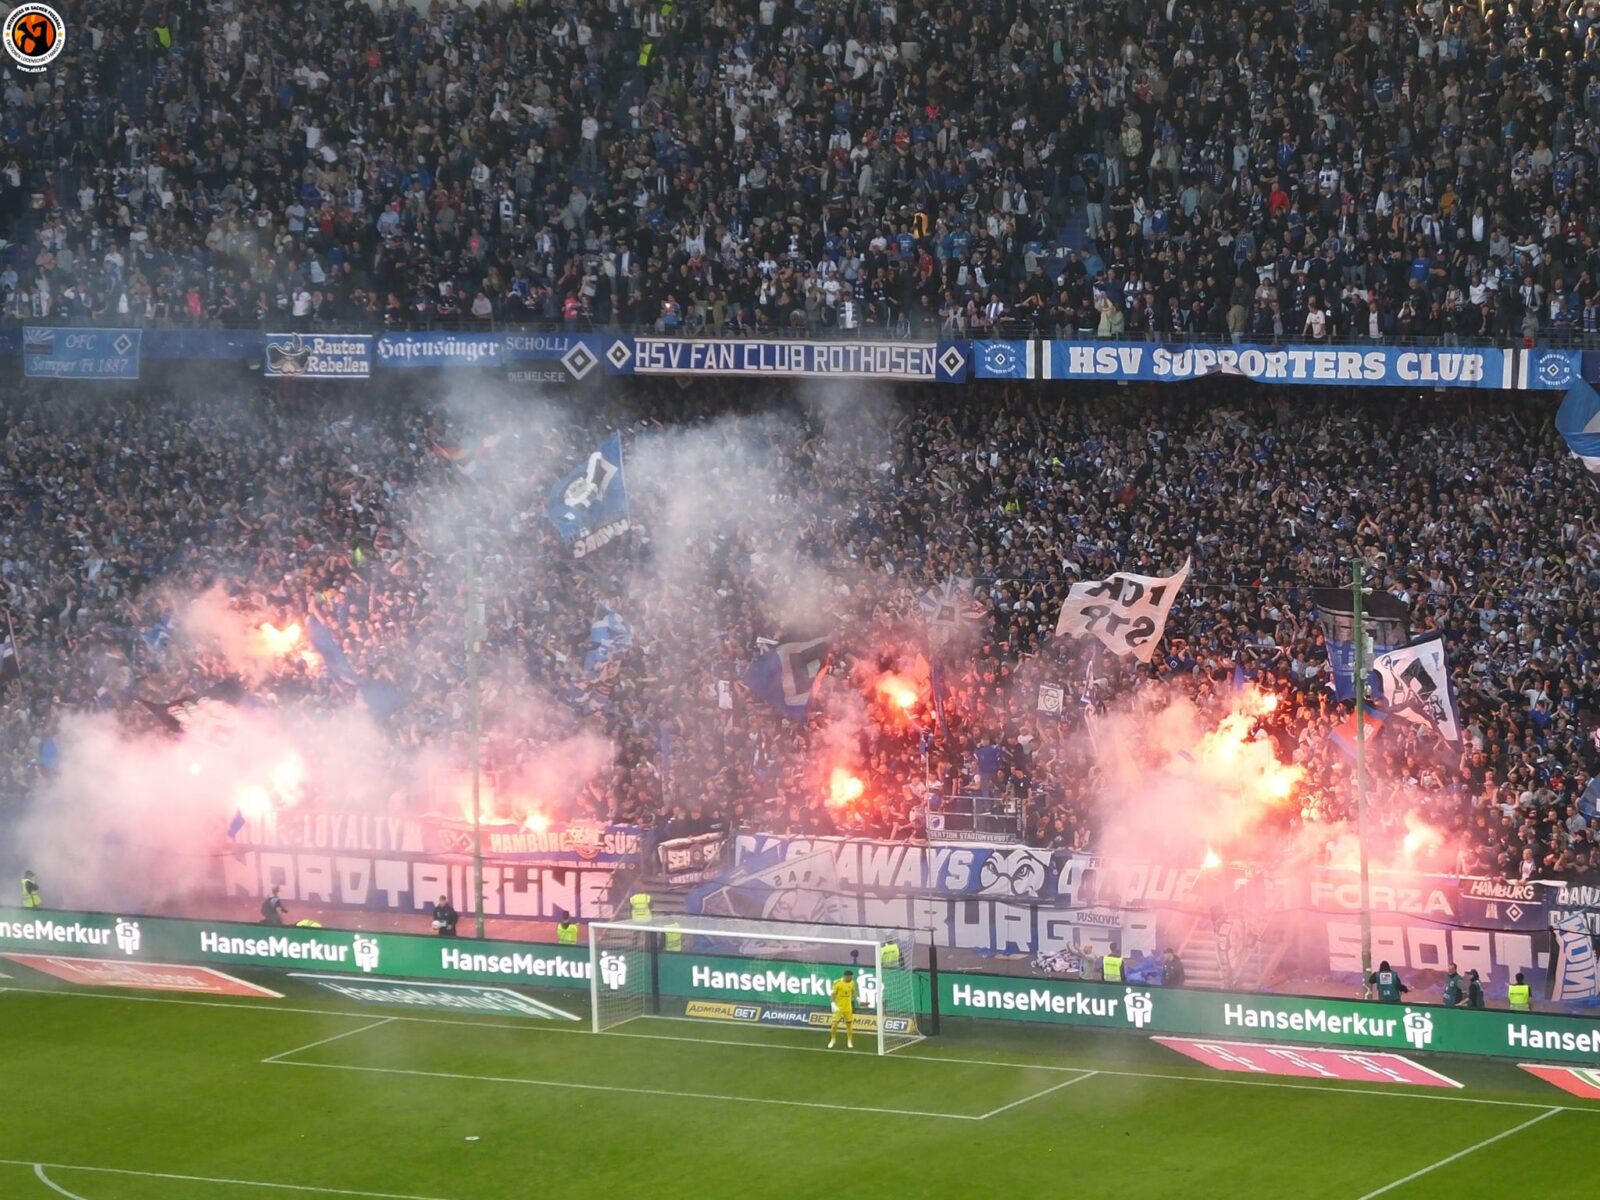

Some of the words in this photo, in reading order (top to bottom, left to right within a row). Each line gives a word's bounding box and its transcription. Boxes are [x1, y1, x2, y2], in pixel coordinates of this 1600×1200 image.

[65, 333, 96, 350] OFC
[312, 338, 366, 355] Rauten
[505, 336, 569, 351] SCHOLLI
[32, 356, 76, 373] Semper
[79, 357, 95, 372] Fi
[98, 358, 129, 374] 1887
[308, 356, 369, 373] Rebellen
[635, 342, 683, 369] HSV
[690, 343, 735, 369] FAN
[743, 344, 805, 371] CLUB
[813, 345, 937, 374] ROTHOSEN
[1069, 346, 1143, 374] HSV
[1153, 347, 1392, 380] SUPPORTERS
[1397, 352, 1483, 381] CLUB
[303, 813, 401, 851] LOYALTY
[1311, 881, 1454, 915] FORZA
[1470, 881, 1535, 900] HAMBURG
[200, 931, 348, 961] HanseMerkur
[692, 965, 834, 996] HanseMerku
[952, 984, 1118, 1016] HanseMerkur
[1224, 1003, 1396, 1037] HanseMerkur
